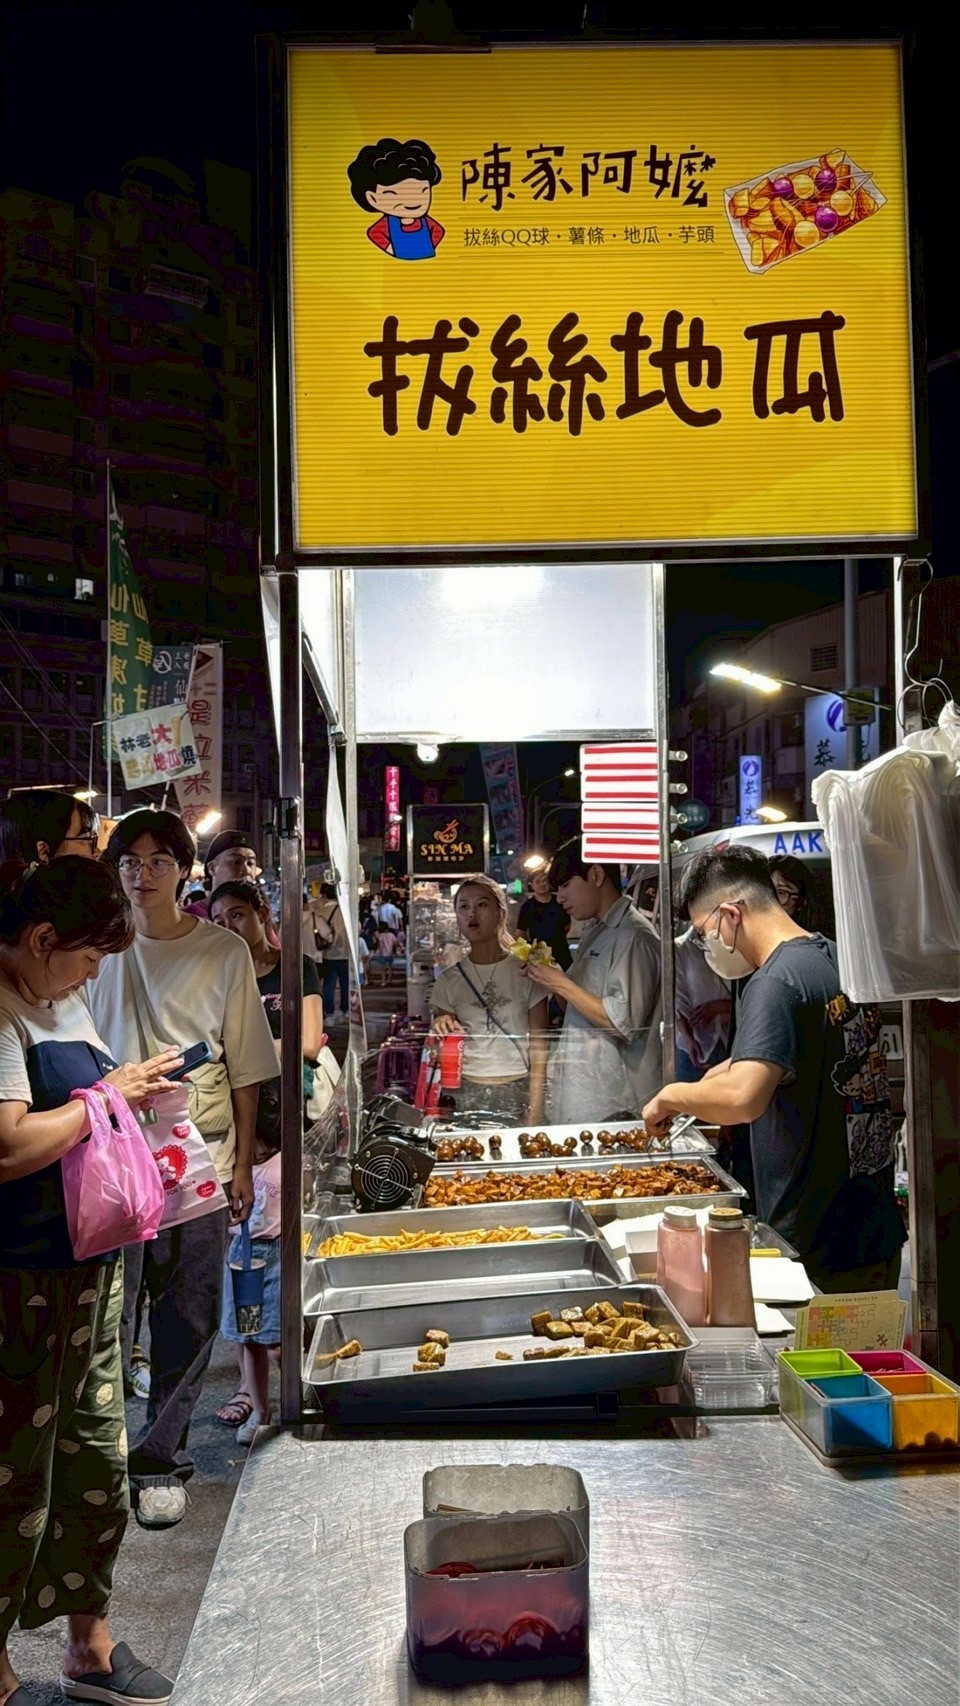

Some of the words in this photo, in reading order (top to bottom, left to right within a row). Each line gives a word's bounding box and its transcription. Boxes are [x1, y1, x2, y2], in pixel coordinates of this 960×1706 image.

[461, 142, 717, 212] 陳家阿嬤
[364, 310, 846, 437] 拔絲地瓜
[450, 841, 474, 855] MA
